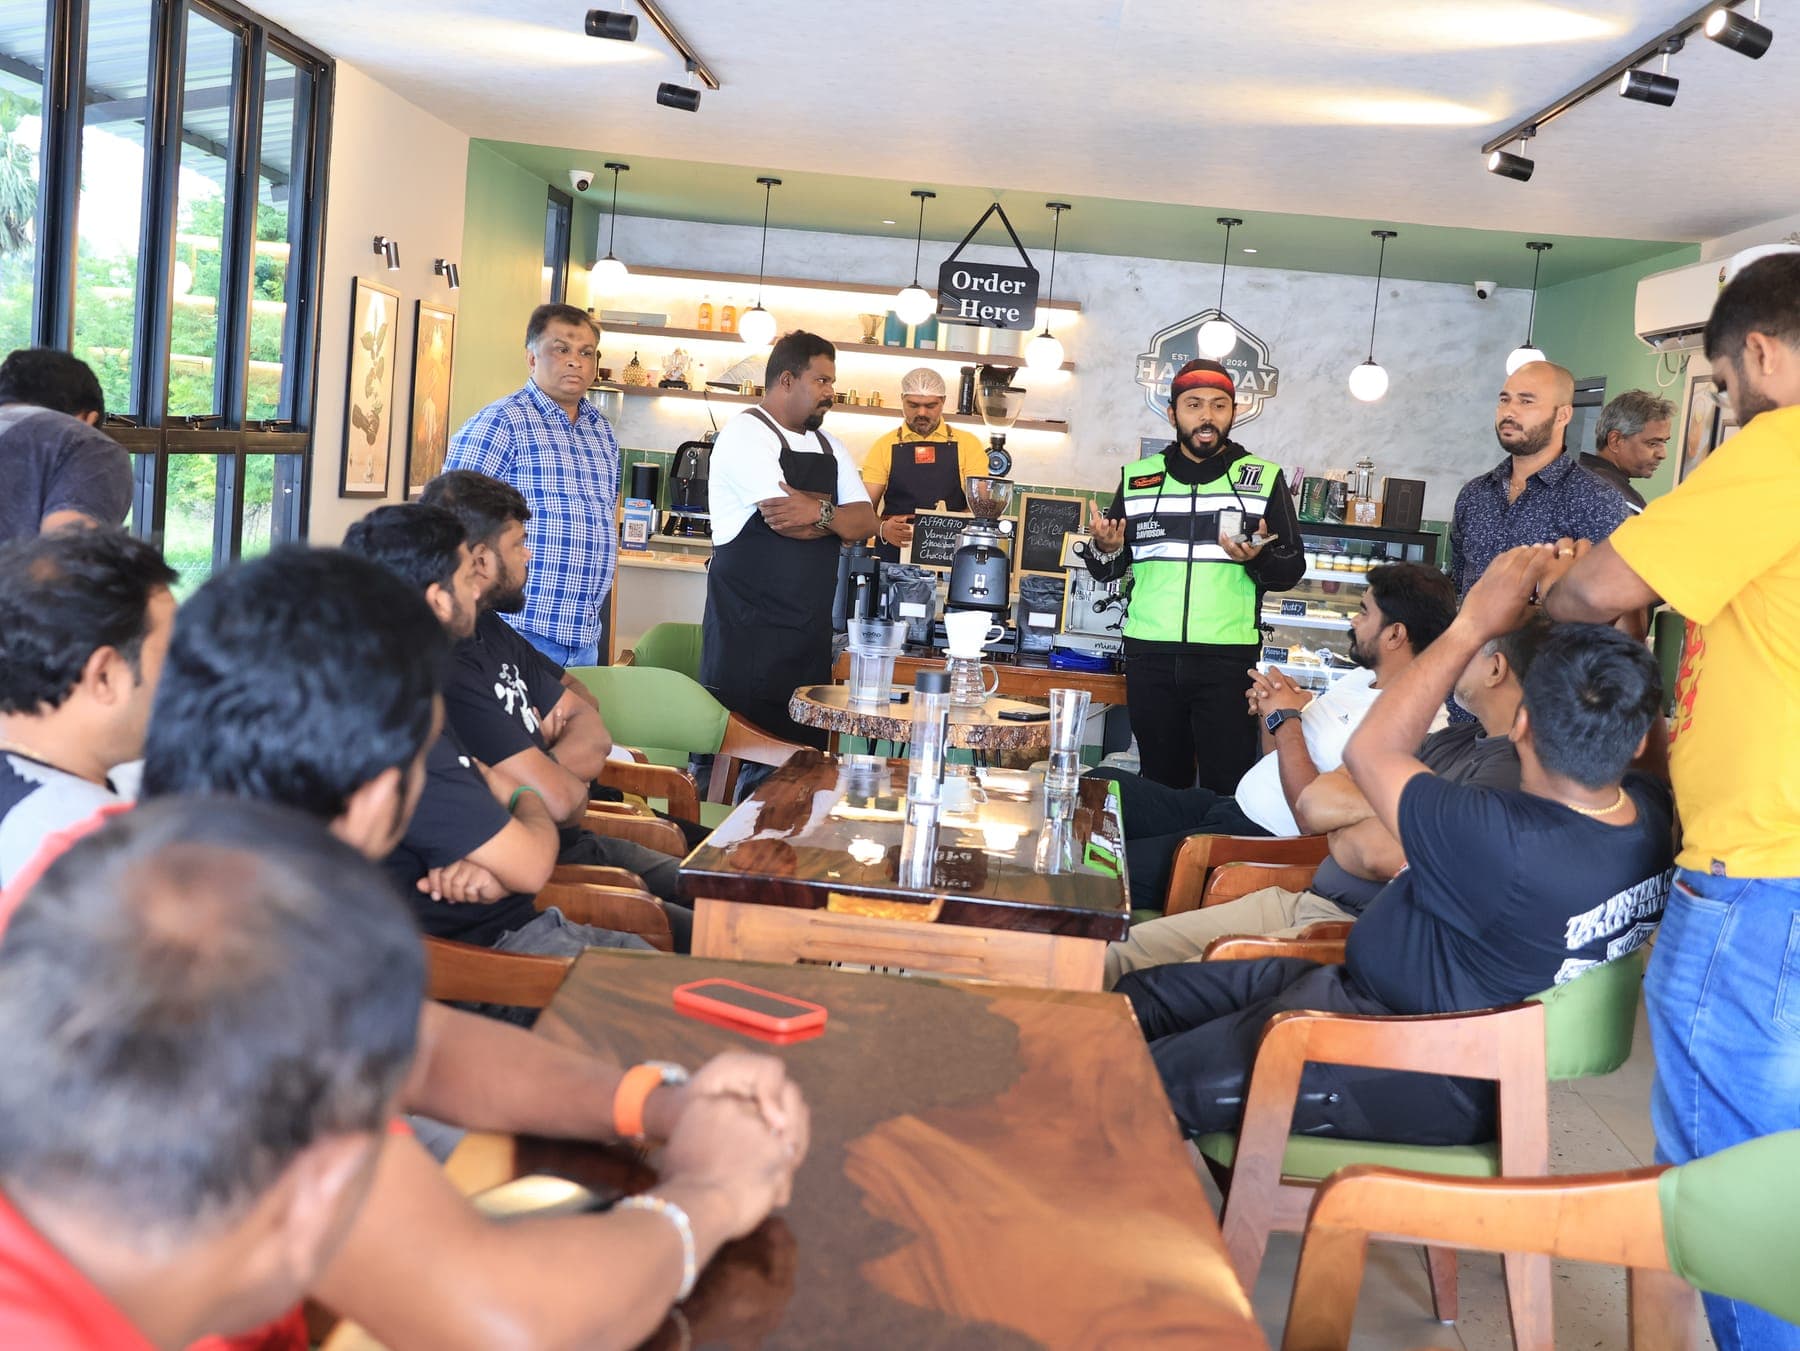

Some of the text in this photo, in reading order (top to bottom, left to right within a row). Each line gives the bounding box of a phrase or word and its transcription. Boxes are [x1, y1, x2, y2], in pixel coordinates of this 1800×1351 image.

[952, 270, 1026, 294] Order
[958, 298, 1020, 322] Here
[1226, 359, 1248, 368] 2024
